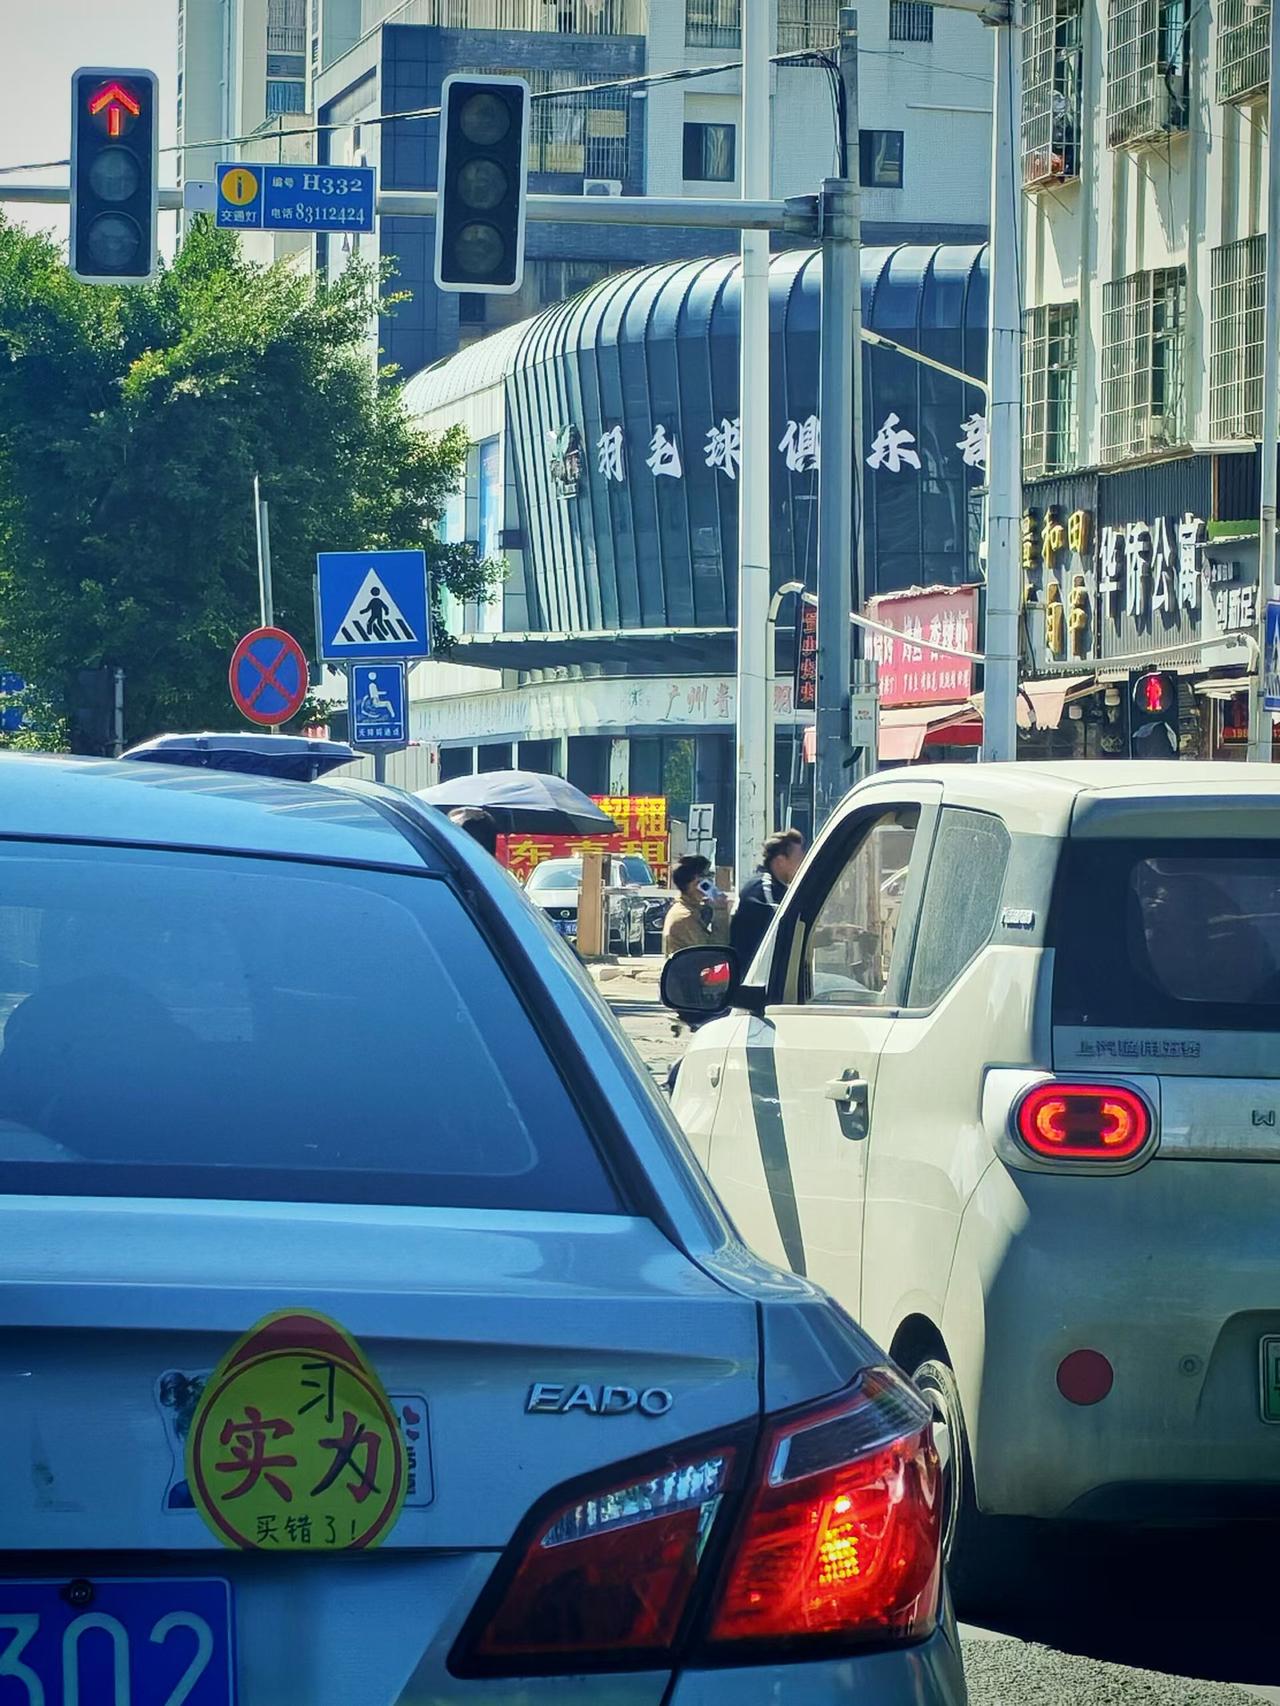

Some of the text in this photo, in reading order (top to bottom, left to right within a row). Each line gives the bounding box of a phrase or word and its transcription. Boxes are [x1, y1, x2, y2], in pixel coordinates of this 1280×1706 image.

[272, 173, 363, 195] 编号 H332
[221, 209, 257, 223] 交通灯
[271, 202, 365, 224] 电话 83112424
[1099, 512, 1204, 618] 华侨公寓
[526, 1382, 674, 1415] EADO
[255, 1514, 357, 1545] 买错了!
